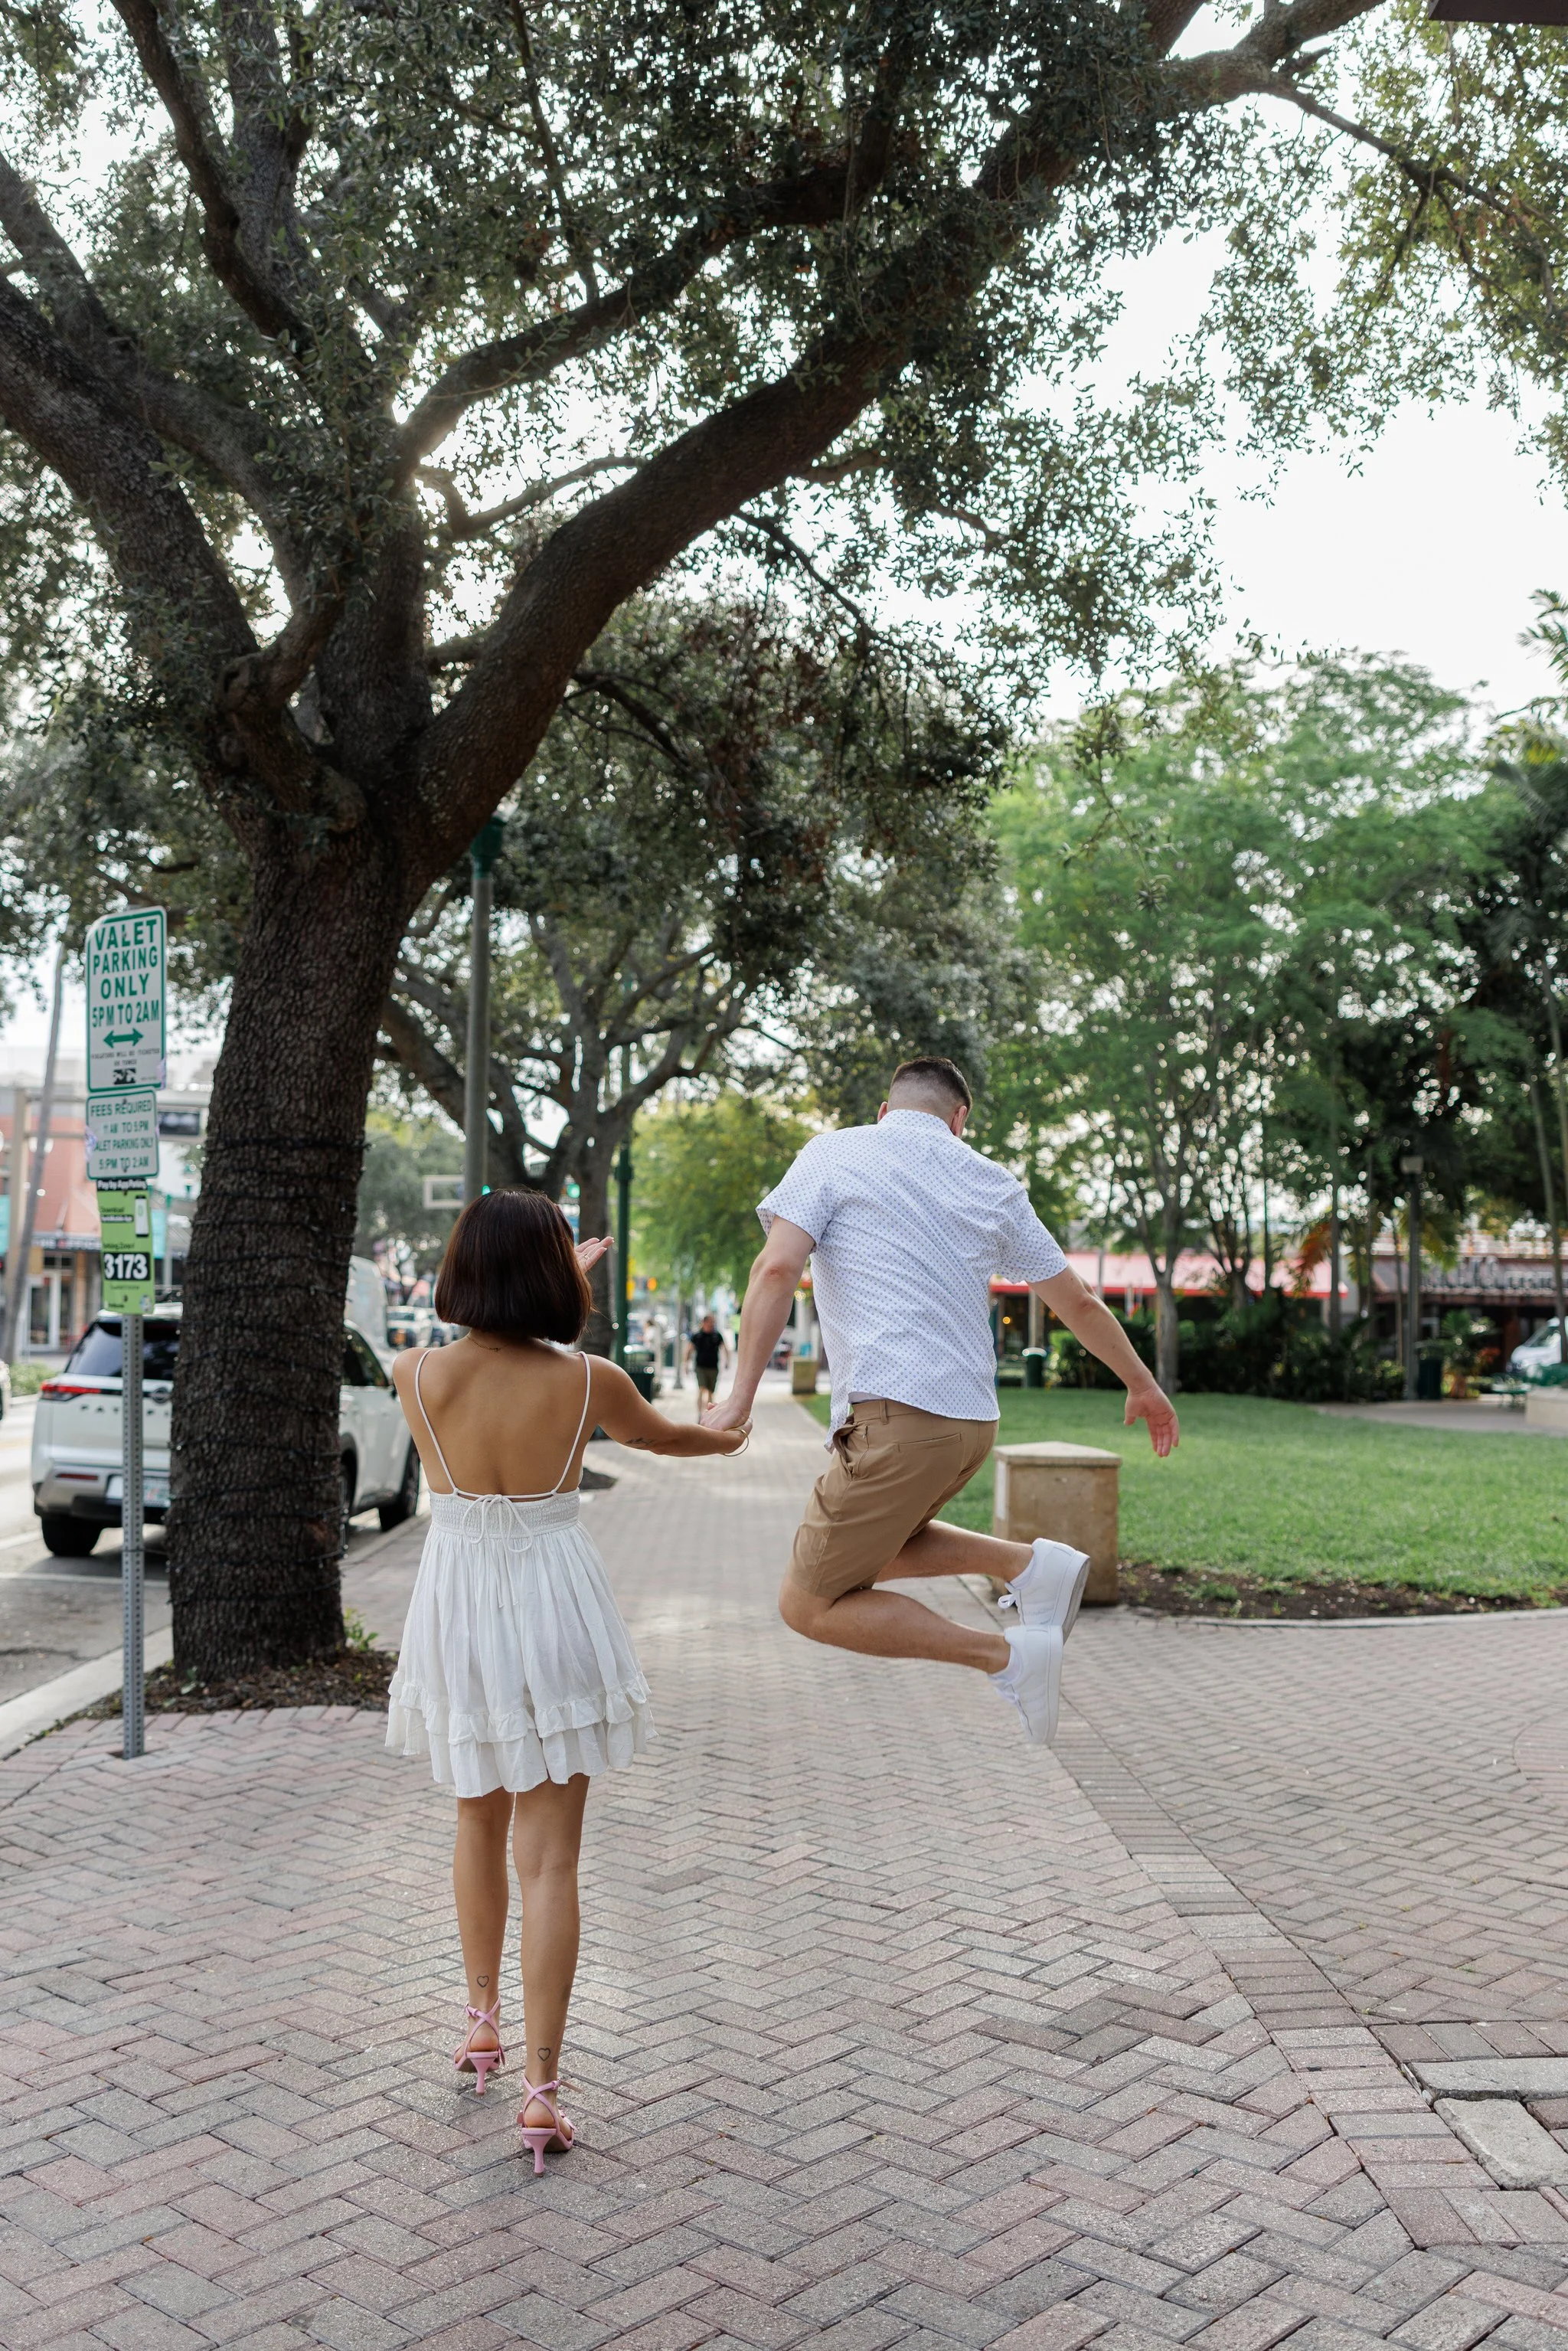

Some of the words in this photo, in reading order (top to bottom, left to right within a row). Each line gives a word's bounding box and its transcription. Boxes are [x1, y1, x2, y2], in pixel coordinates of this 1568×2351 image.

[95, 919, 157, 950] VALET
[93, 946, 158, 975] PARKING
[100, 973, 149, 999] ONLY
[92, 1005, 114, 1027] 5PM
[117, 1003, 132, 1025] TO
[136, 999, 159, 1022] 2AM
[91, 1104, 113, 1117] FEES
[115, 1100, 152, 1115] REQUIRED
[122, 1122, 132, 1133] TO
[94, 1140, 110, 1151] ALET
[113, 1138, 139, 1149] PARKING
[103, 1254, 149, 1279] 3173
